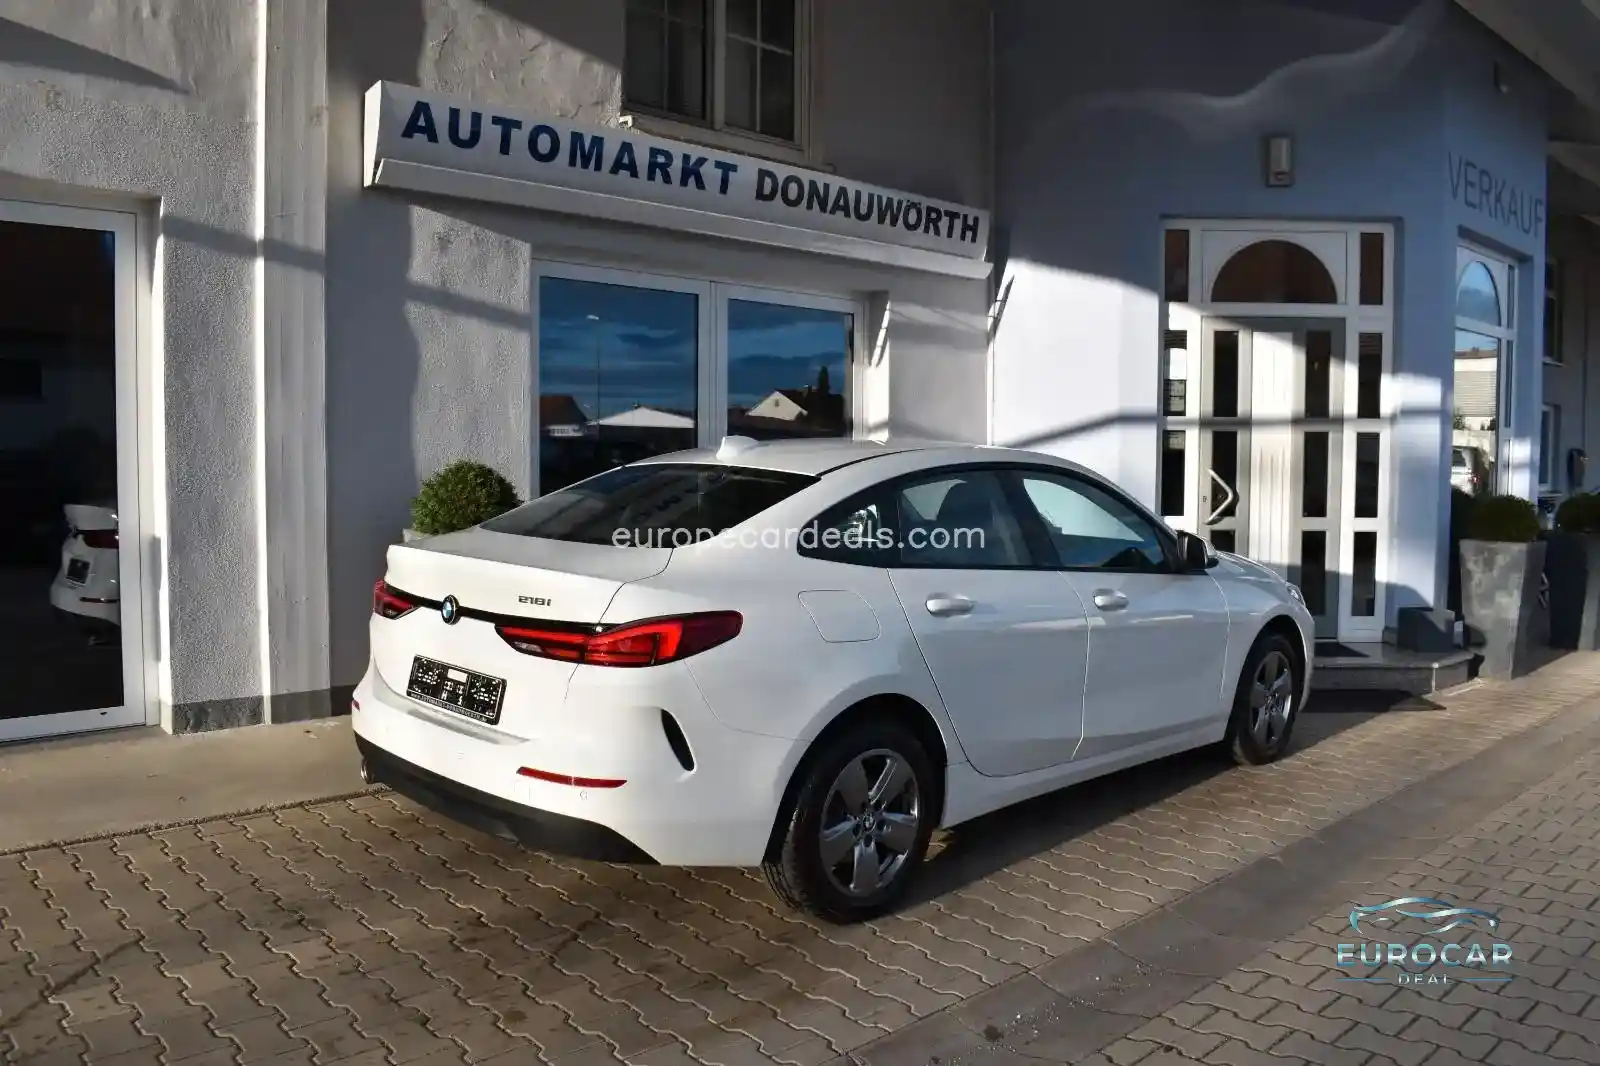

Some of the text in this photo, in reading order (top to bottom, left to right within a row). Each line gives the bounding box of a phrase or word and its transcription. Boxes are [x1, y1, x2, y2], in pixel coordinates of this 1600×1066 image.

[401, 100, 979, 243] AUTOMARKT DONAUWÖRTH
[1448, 151, 1544, 239] VERKAUF
[518, 595, 552, 606] 218i
